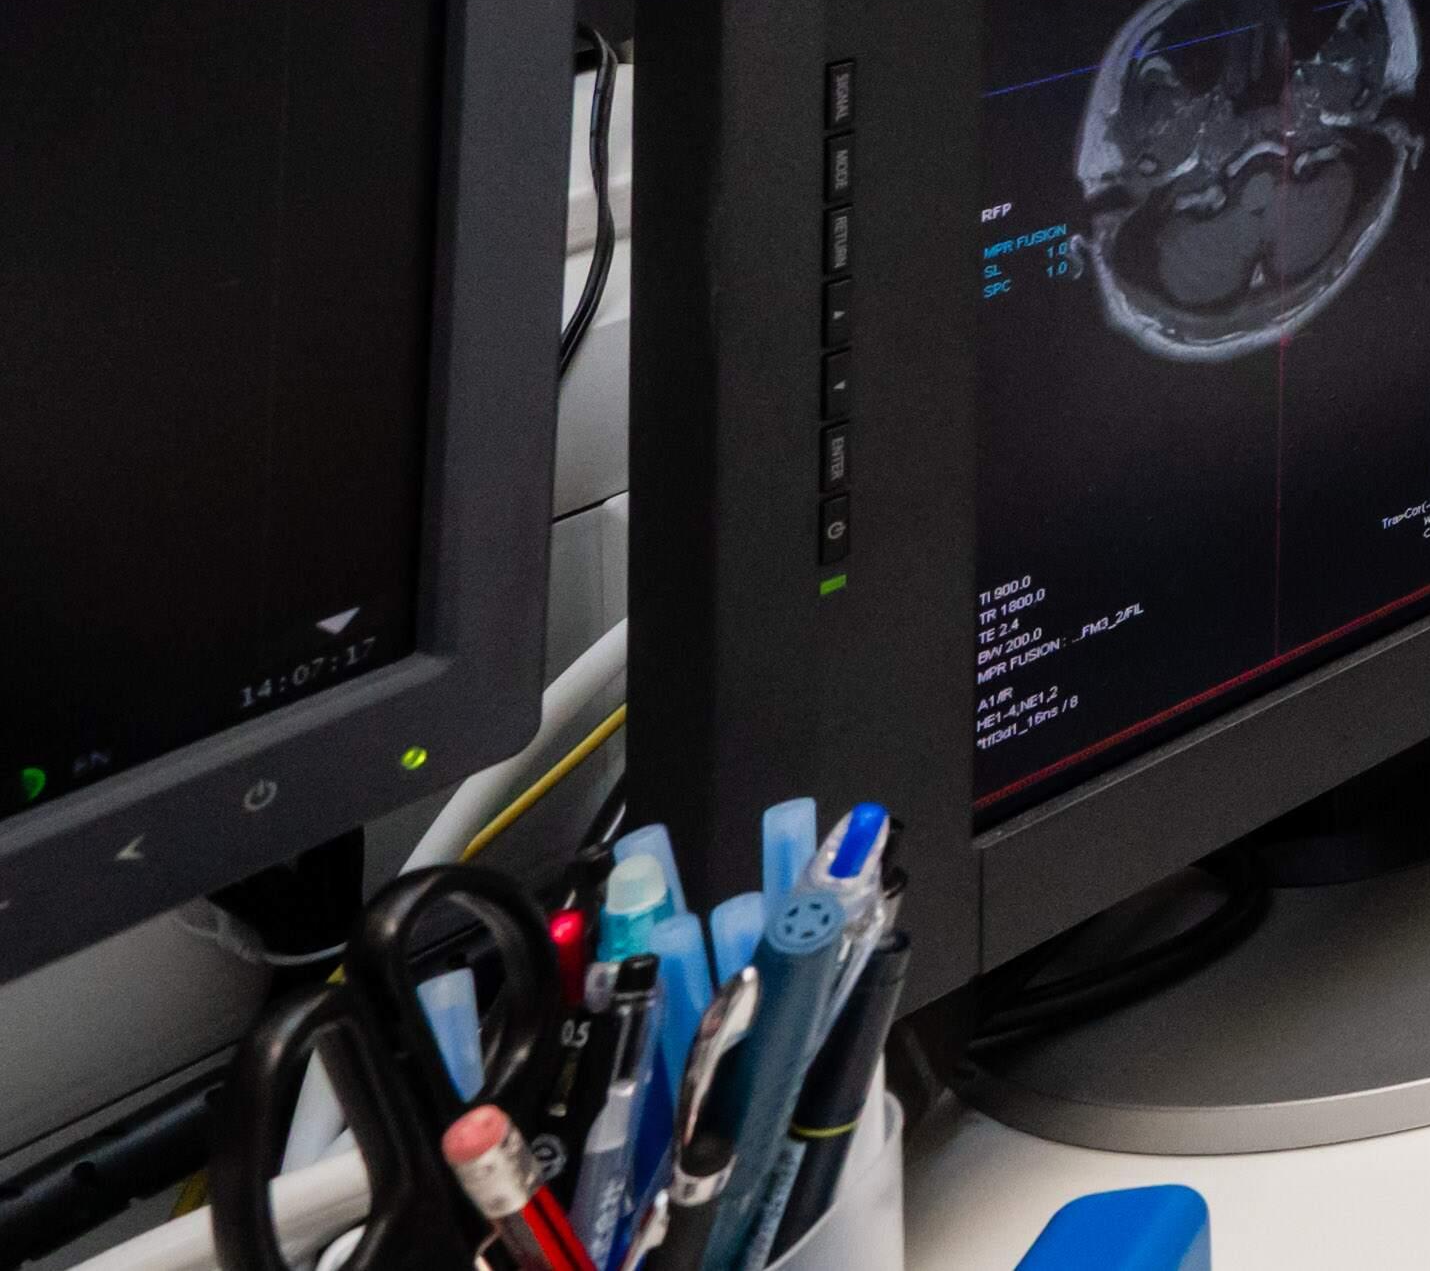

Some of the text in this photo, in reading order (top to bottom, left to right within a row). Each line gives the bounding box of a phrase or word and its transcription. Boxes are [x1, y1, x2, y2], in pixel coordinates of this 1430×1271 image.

[835, 72, 848, 122] SIGNAL
[835, 148, 848, 190] MODE
[981, 203, 1011, 222] RFP
[833, 215, 848, 270] RETURN
[831, 436, 845, 481] ENTER
[240, 637, 377, 708] 14:07:17
